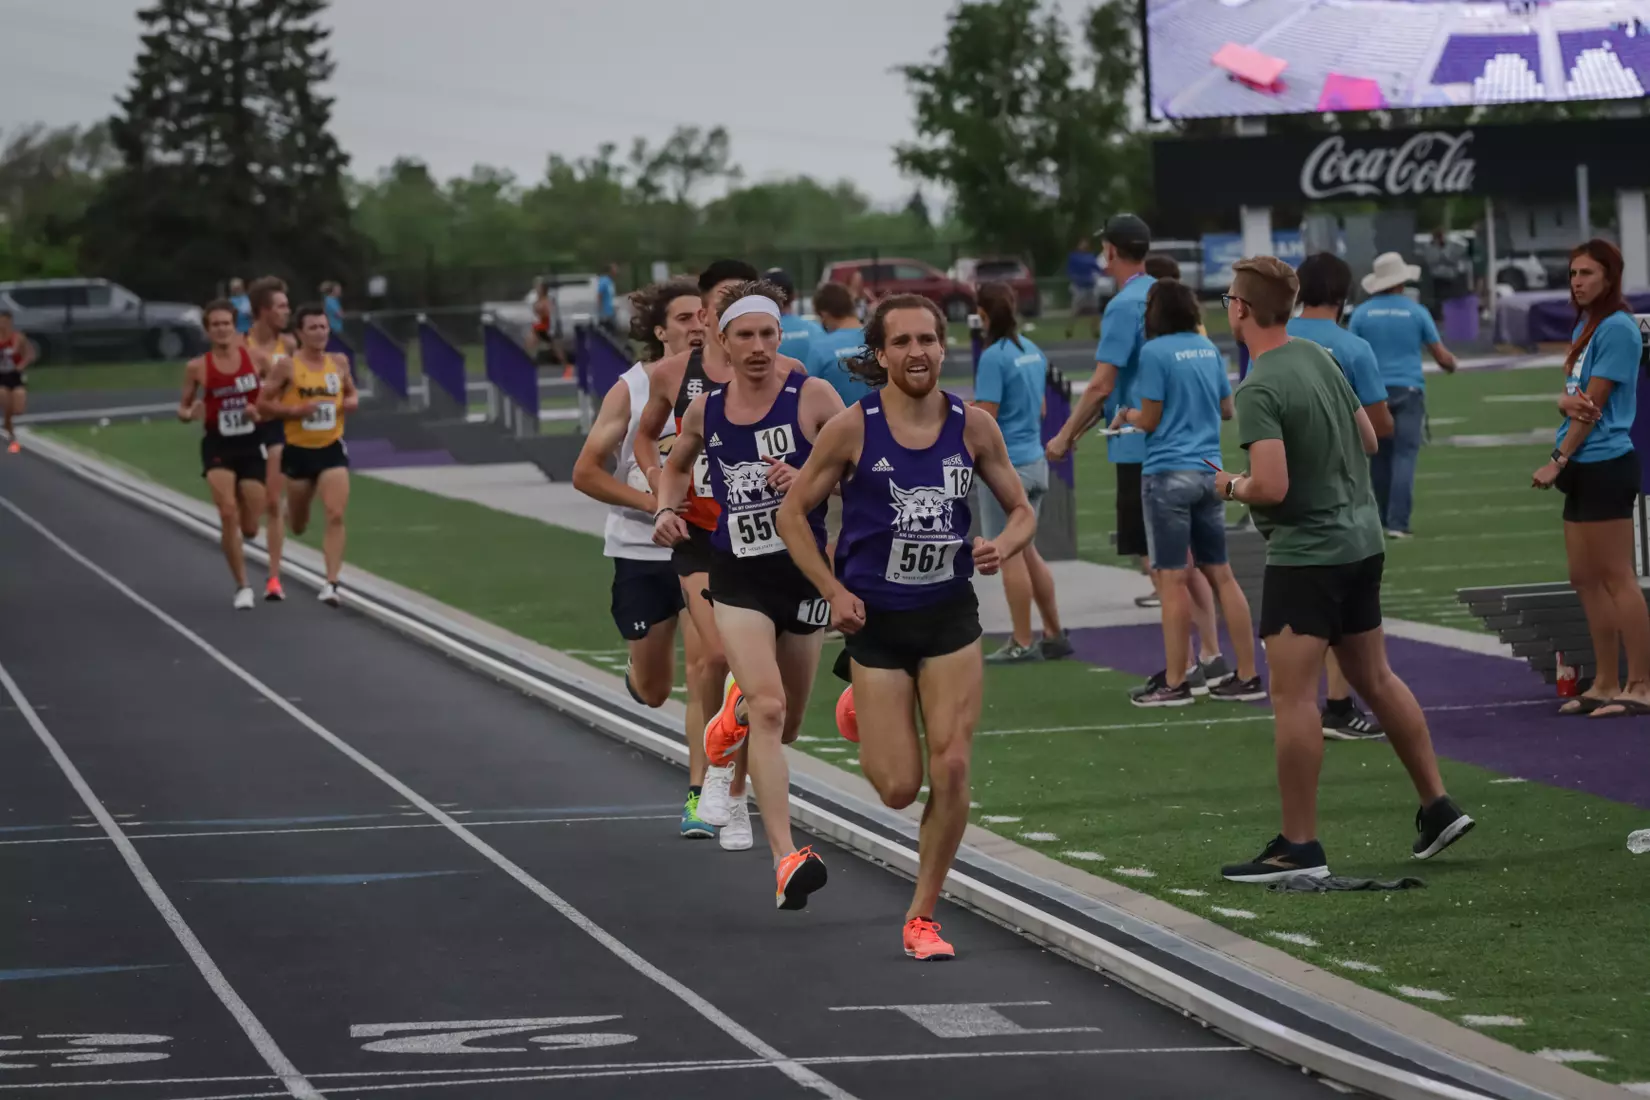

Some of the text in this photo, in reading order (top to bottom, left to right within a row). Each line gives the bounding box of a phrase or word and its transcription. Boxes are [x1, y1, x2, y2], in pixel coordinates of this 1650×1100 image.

[1300, 130, 1475, 198] Coca-Cola
[761, 427, 789, 456] 10
[949, 468, 970, 496] 18
[899, 542, 950, 573] 561
[806, 598, 828, 624] 10
